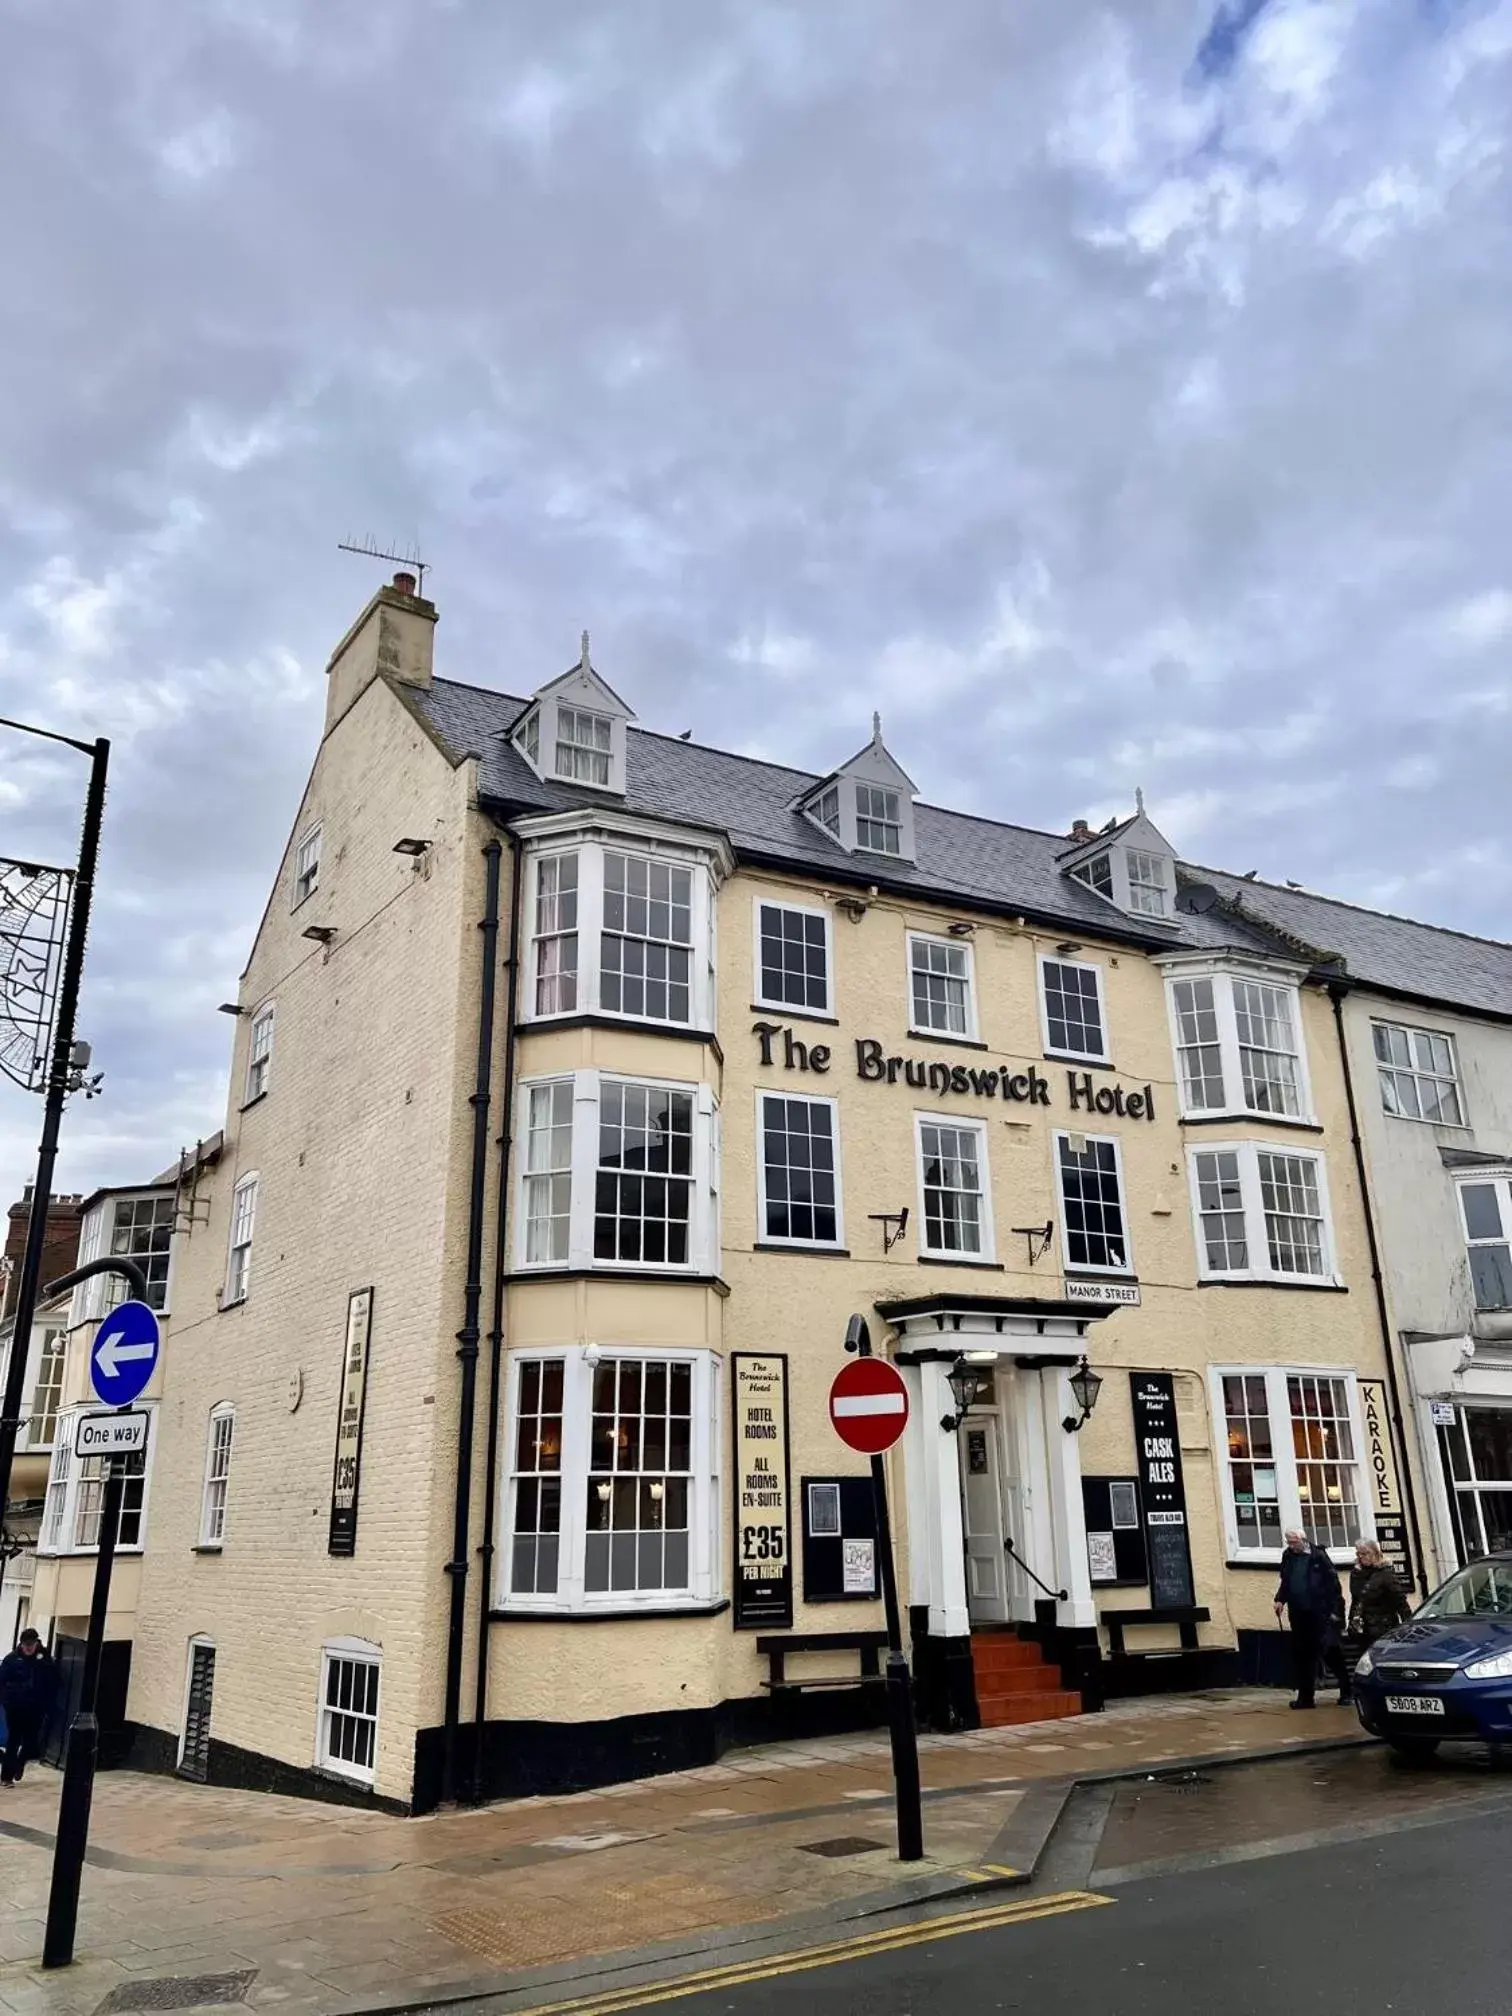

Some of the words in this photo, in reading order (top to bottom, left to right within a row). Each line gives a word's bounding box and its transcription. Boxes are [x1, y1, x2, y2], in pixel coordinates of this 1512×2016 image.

[752, 1022, 831, 1073] The
[855, 1038, 1051, 1106] Brunswick
[1067, 1070, 1155, 1121] Hotel
[1069, 1285, 1101, 1298] MANOR
[1105, 1287, 1136, 1300] STREET
[752, 1362, 767, 1371] The
[739, 1371, 780, 1381] Brunswick
[749, 1382, 771, 1392] Hotel
[1146, 1383, 1159, 1392] The
[747, 1407, 773, 1422] HOTEL
[84, 1426, 109, 1444] One
[114, 1427, 140, 1444] way
[745, 1425, 777, 1440] ROOMS
[1144, 1437, 1174, 1458] CASK
[1362, 1386, 1391, 1508] KARAOKE
[754, 1457, 769, 1471] ALL
[1149, 1461, 1175, 1483] ALES
[746, 1474, 778, 1489] ROOMS
[743, 1492, 782, 1507] EN-SUITE
[743, 1525, 783, 1560] £35
[743, 1566, 759, 1580] PER
[760, 1565, 783, 1579] NIGHT
